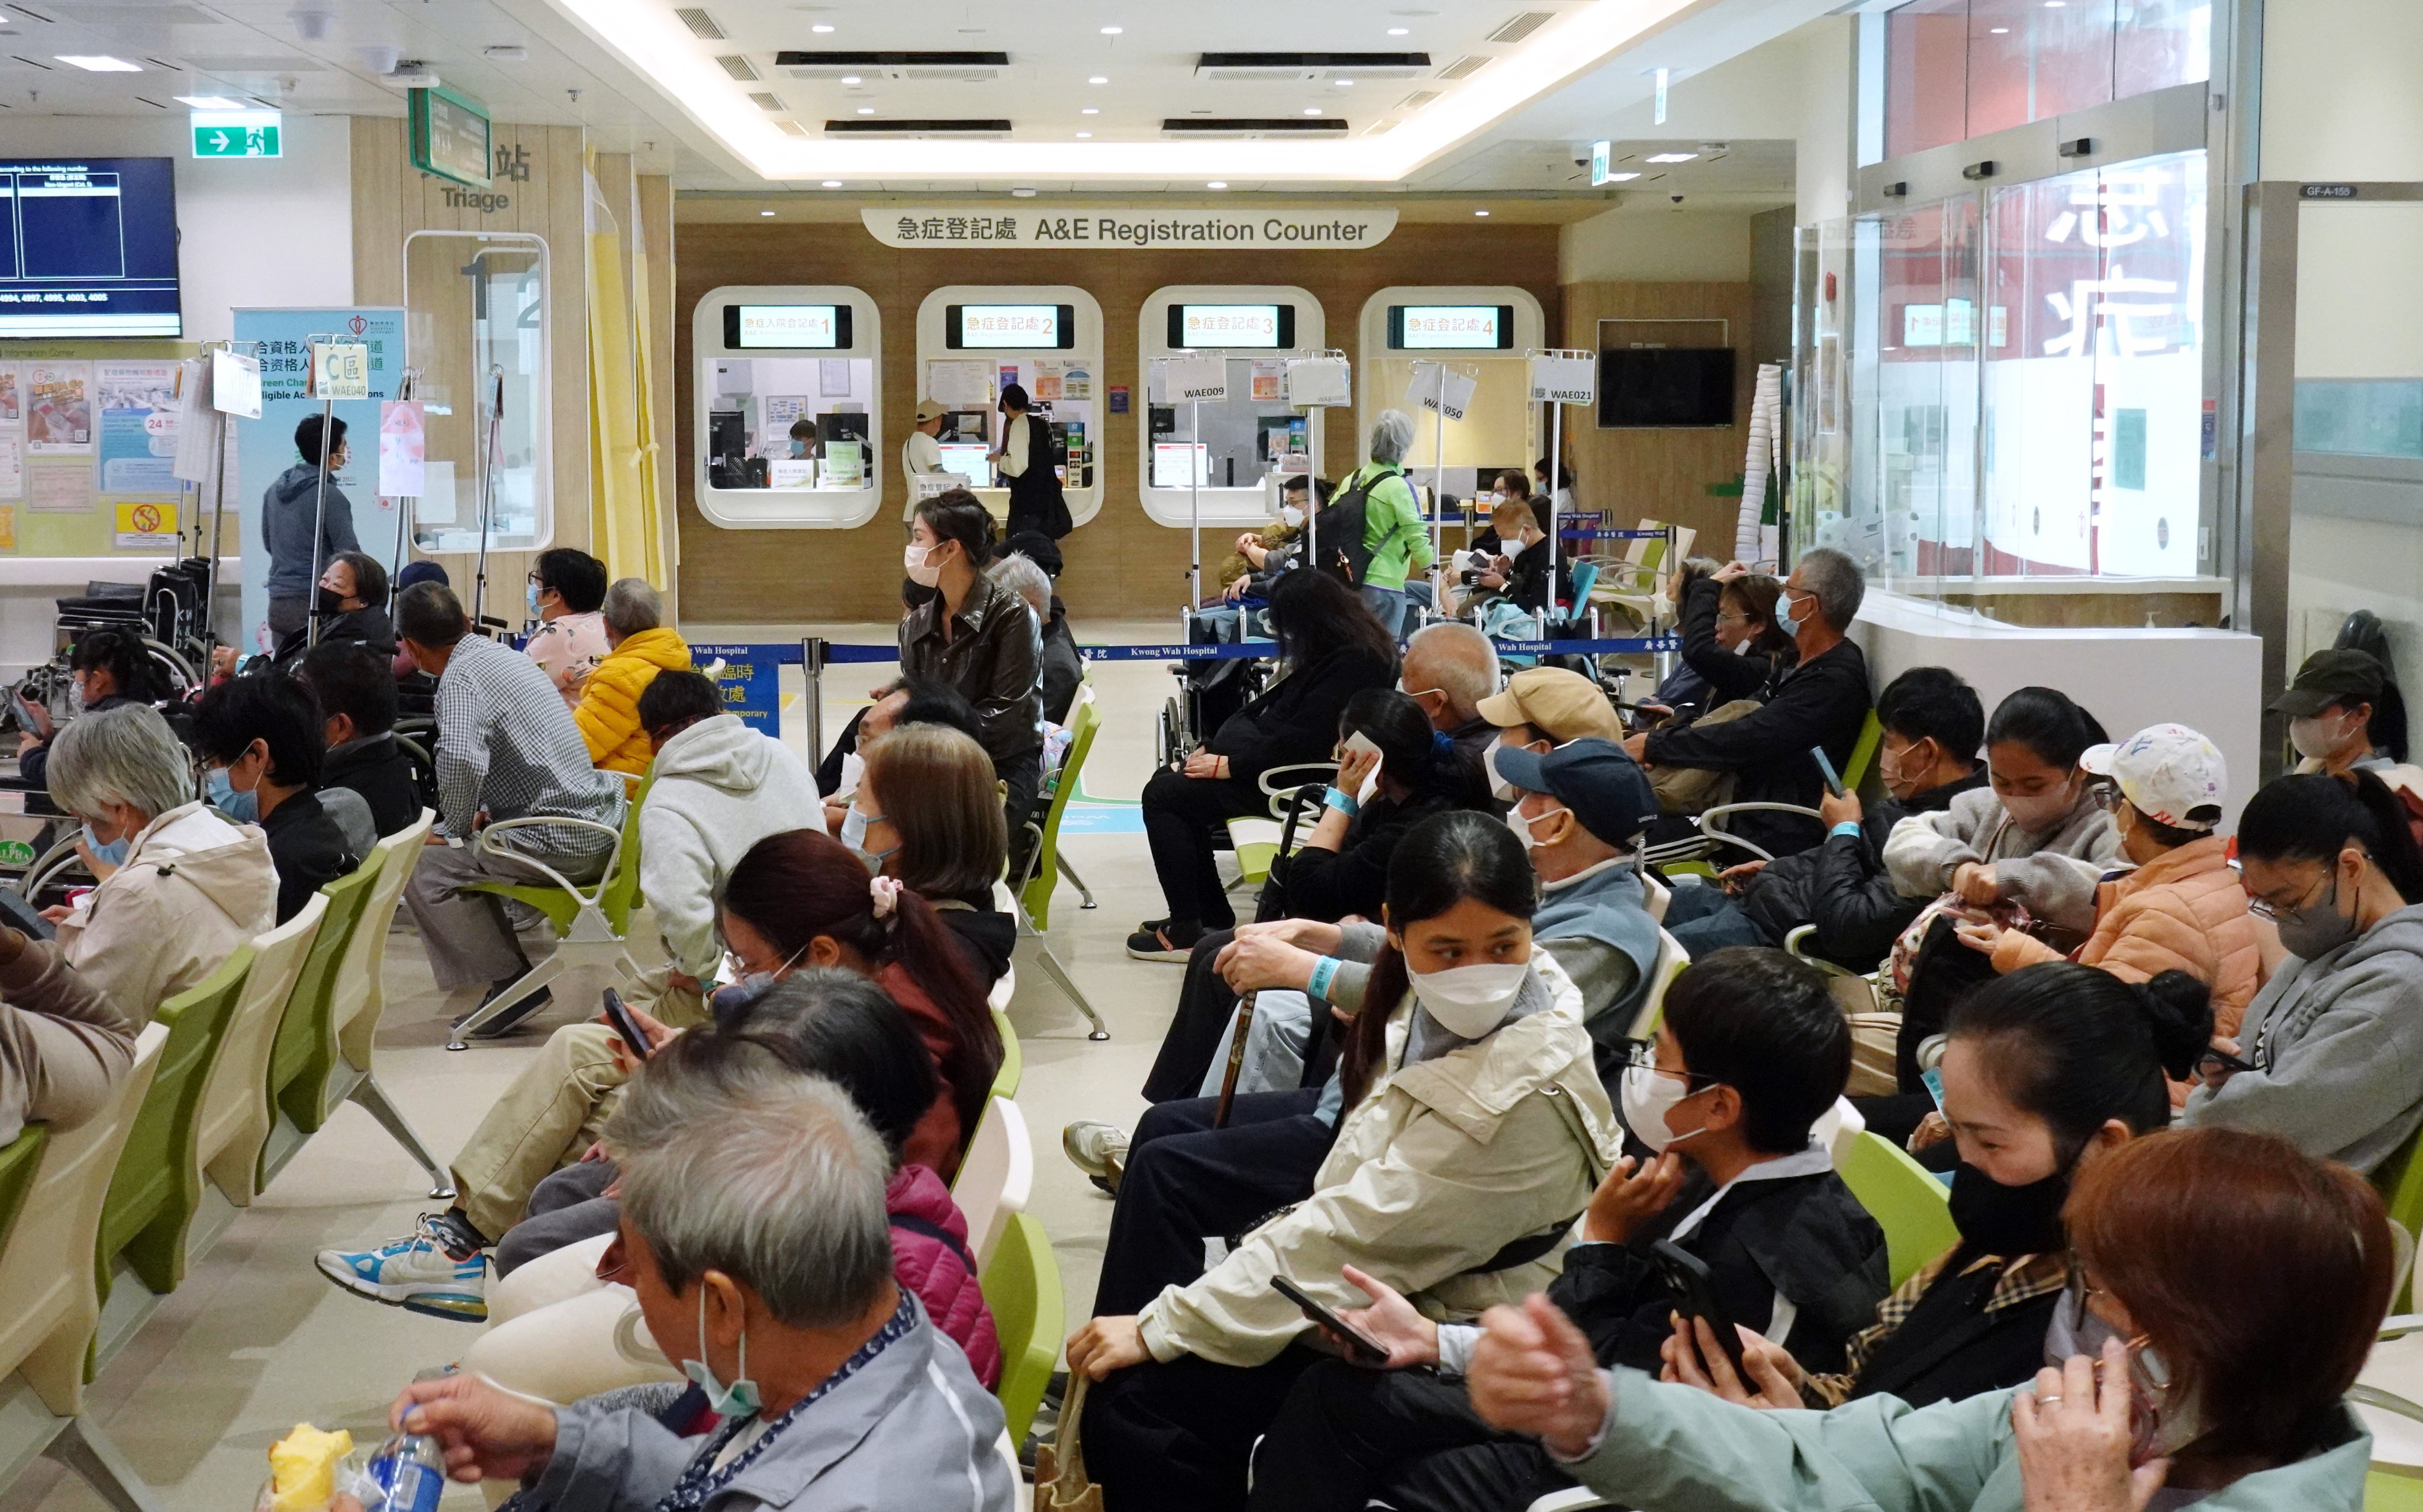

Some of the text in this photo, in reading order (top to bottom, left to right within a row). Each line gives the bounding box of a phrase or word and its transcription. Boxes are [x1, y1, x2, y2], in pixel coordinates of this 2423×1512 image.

[495, 144, 530, 182] 站
[440, 188, 509, 213] Triage
[897, 217, 1367, 246] 急症登記處 A&E Registration Counter
[745, 318, 818, 328] 急症入院登記處
[821, 318, 829, 334] 1
[967, 317, 1039, 330] 急症登記處
[1042, 318, 1053, 334] 2
[1187, 316, 1259, 330] 急症登記處
[1263, 318, 1274, 334] 3
[1409, 318, 1480, 331] 急症登記處
[1482, 320, 1494, 335] 4
[332, 385, 366, 395] WAE040
[1184, 387, 1224, 398] WAE009
[1551, 390, 1591, 400] WAE021
[149, 419, 162, 428] 24
[695, 646, 748, 656] Wah Hospital
[1131, 648, 1160, 657] Kwong
[1183, 647, 1217, 656] Hospital
[1519, 643, 1551, 652] Hospital
